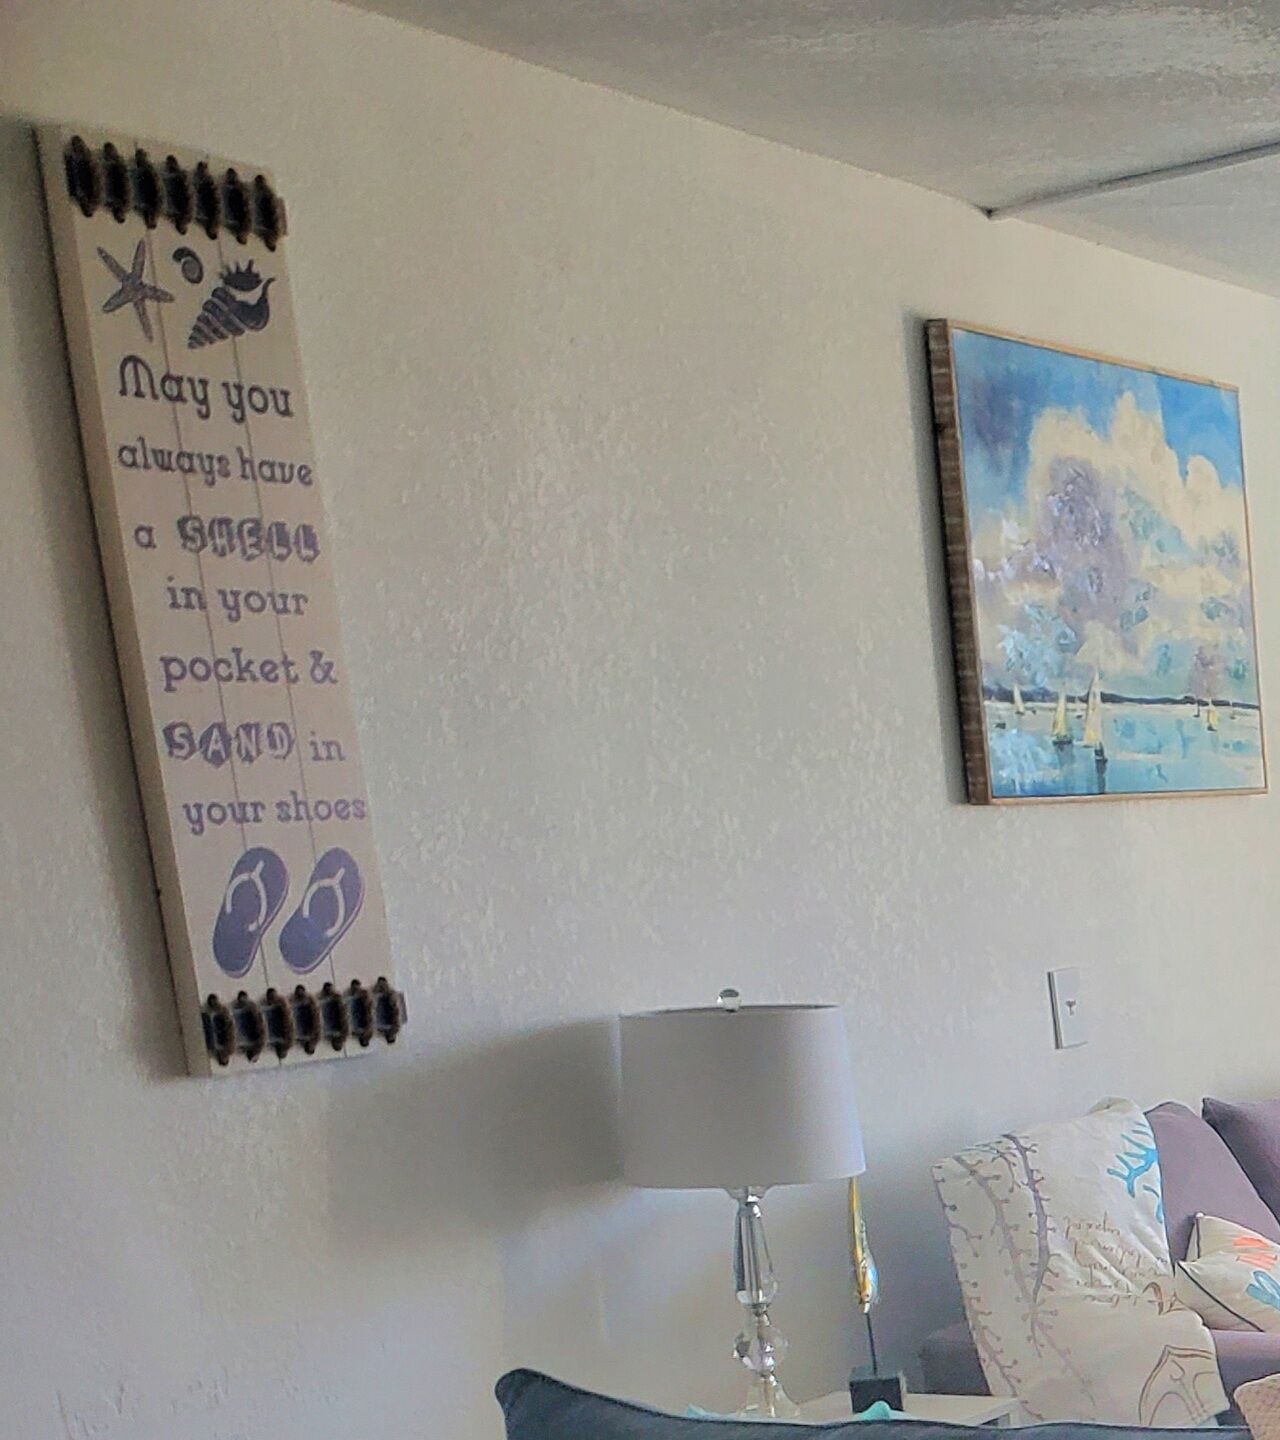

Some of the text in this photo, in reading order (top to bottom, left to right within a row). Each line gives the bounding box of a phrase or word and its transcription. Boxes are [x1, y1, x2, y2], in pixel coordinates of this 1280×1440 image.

[118, 354, 295, 424] May you
[118, 435, 314, 487] always have
[134, 514, 321, 564] a SHELL
[166, 575, 310, 623] in your
[159, 646, 338, 692] pocket &
[162, 720, 346, 768] SAND in
[182, 789, 367, 836] your shoes
